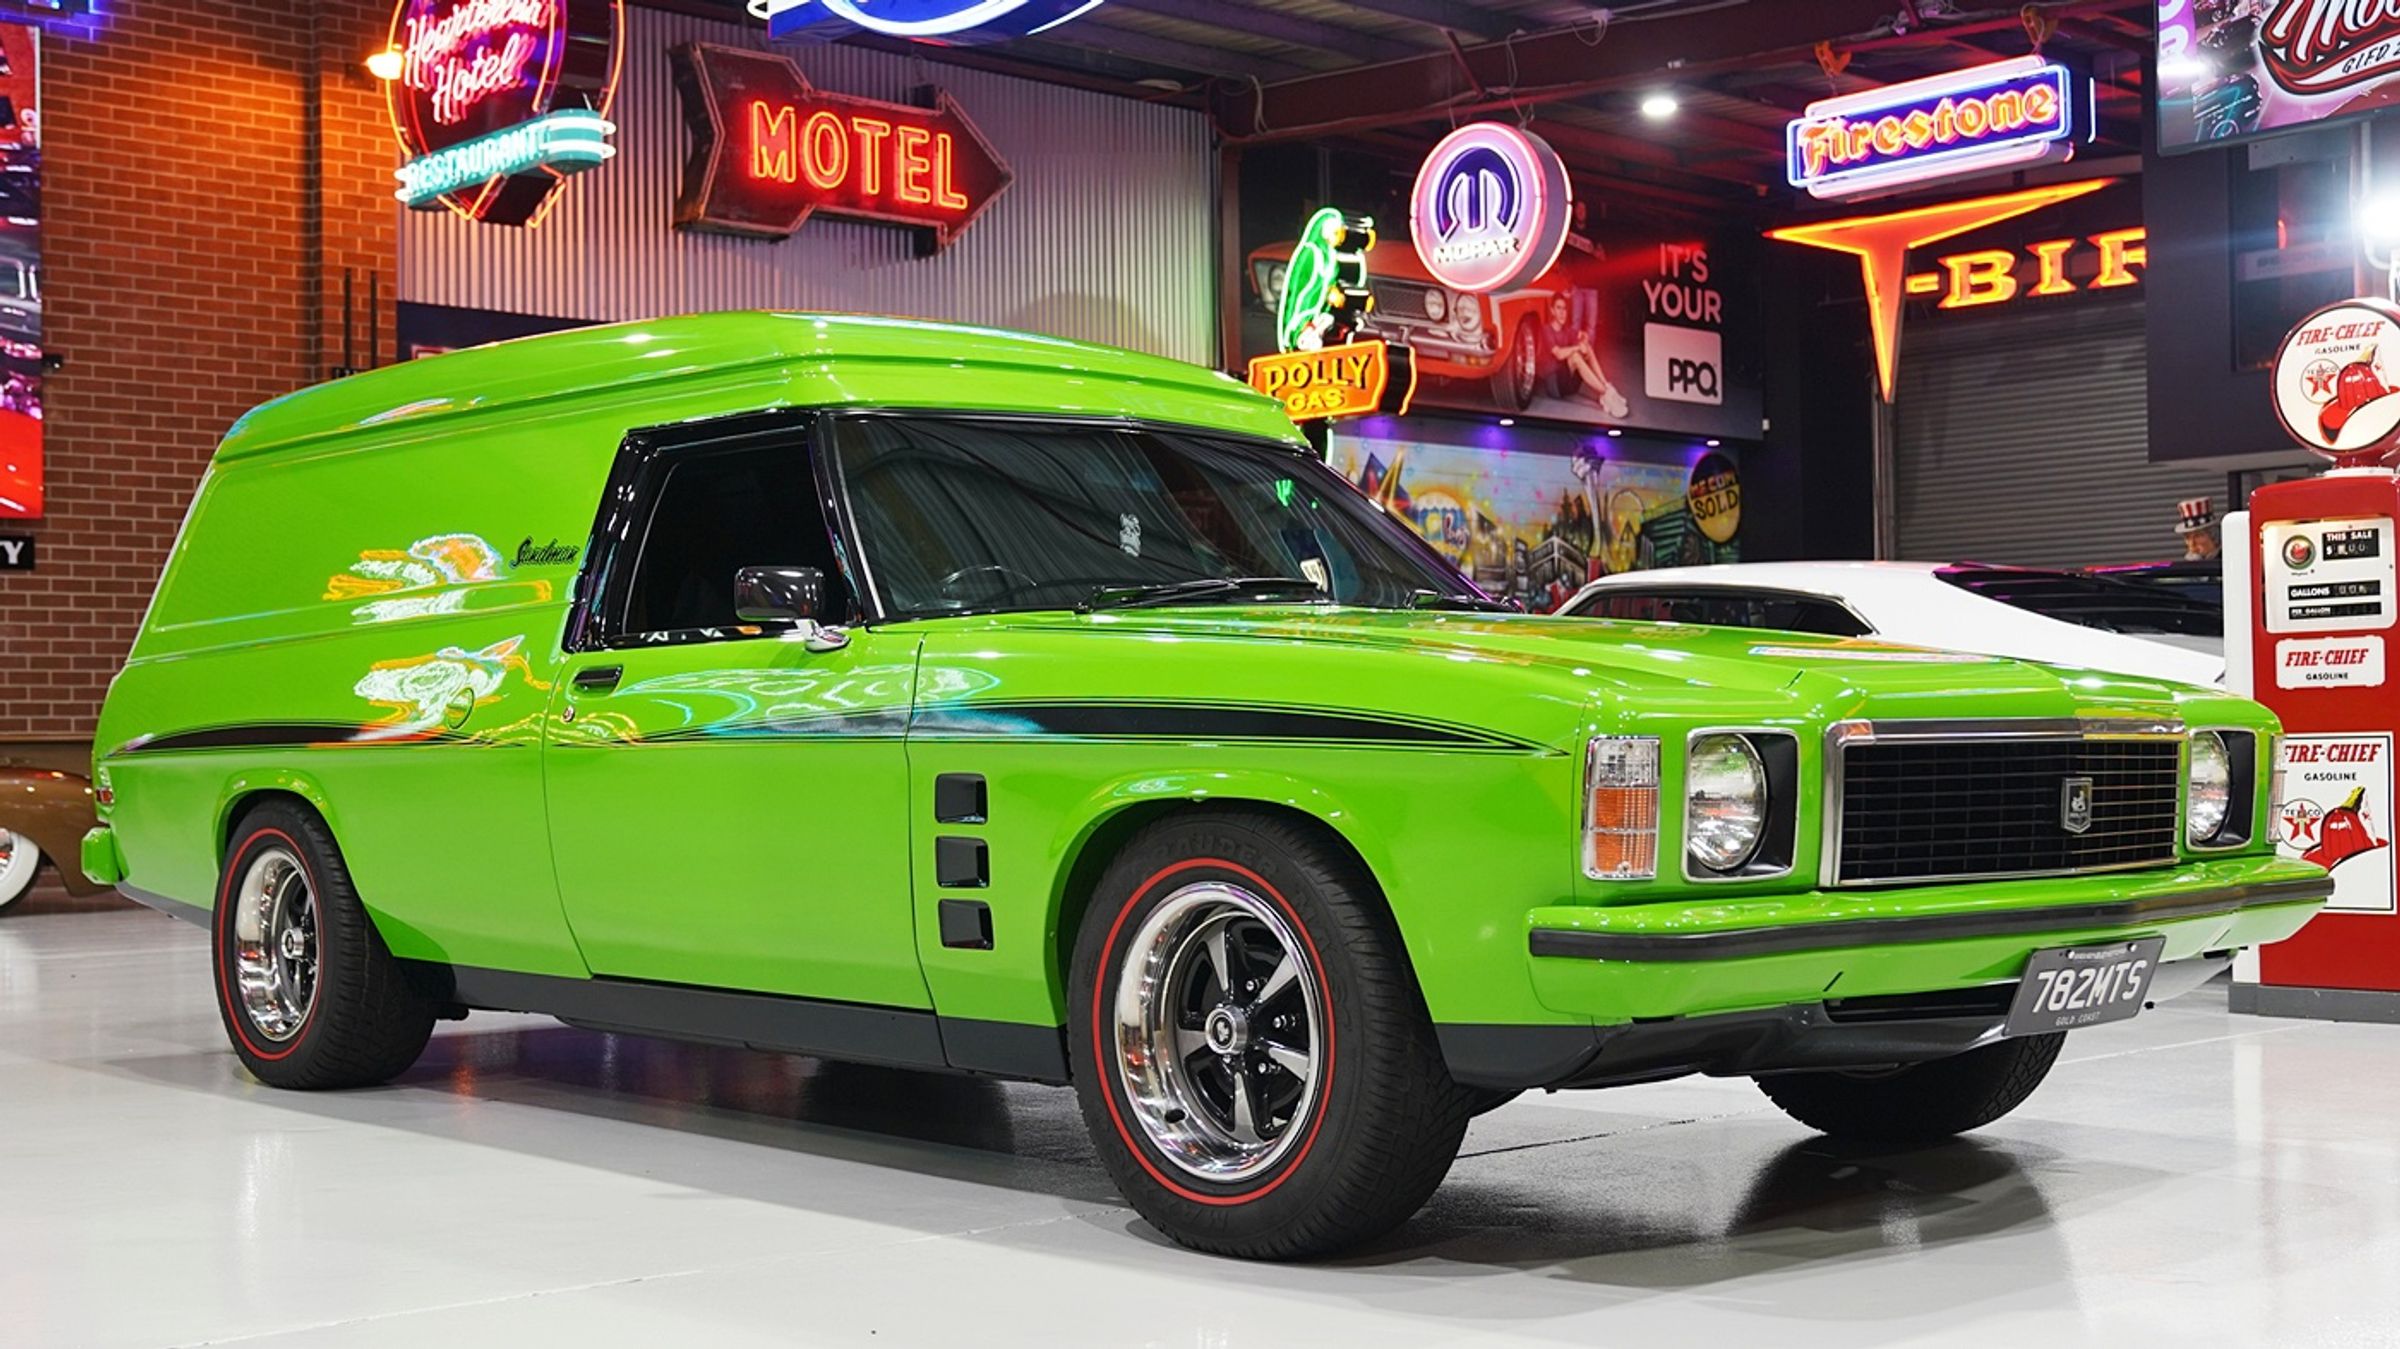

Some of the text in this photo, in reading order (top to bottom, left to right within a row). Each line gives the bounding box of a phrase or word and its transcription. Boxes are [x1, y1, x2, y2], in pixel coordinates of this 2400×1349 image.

[431, 32, 521, 123] Hotel
[1797, 83, 2059, 178] Firestone
[405, 124, 543, 194] RESTAURANT
[752, 100, 969, 210] MOTEL
[1432, 236, 1521, 264] MOPAR
[1660, 242, 1709, 283] IT'S
[1643, 279, 1722, 324] YOUR
[1762, 177, 2147, 404] T-BIR
[2296, 320, 2387, 347] FIRE-CHIEF
[2314, 343, 2361, 355] GASOLINE
[1262, 353, 1373, 397] POLLY
[1668, 357, 1719, 398] PPQ
[1287, 388, 1345, 412] GAS
[1694, 489, 1738, 520] SOLD
[2326, 530, 2373, 541] THIS SALE
[2290, 586, 2331, 598] GALLONS
[2305, 606, 2331, 617] GALLON
[2285, 648, 2369, 667] FIRE-CHIEF
[2306, 672, 2349, 681] GASOLINE
[2304, 772, 2358, 782] GASOLINE
[2032, 959, 2148, 1014] 782MTS
[2055, 1010, 2101, 1026] GOLD COAST
